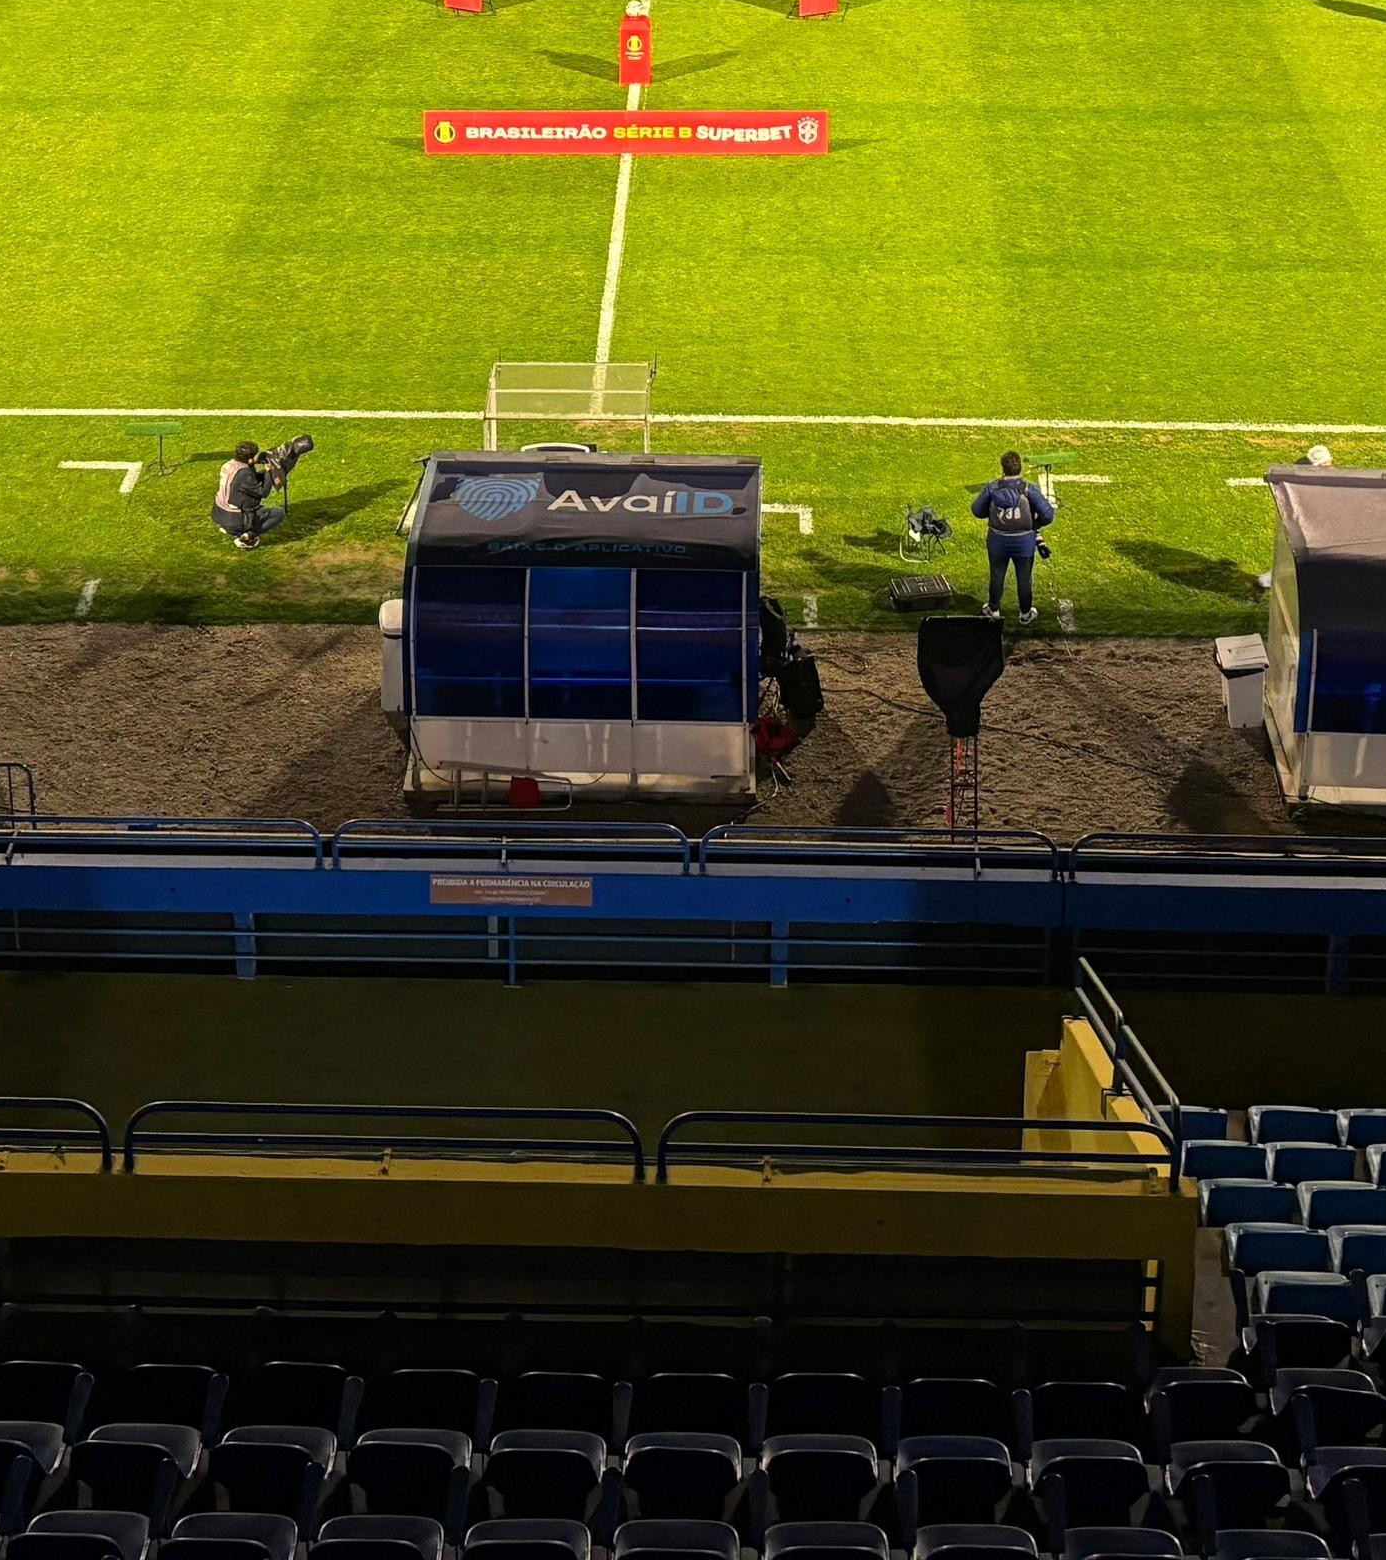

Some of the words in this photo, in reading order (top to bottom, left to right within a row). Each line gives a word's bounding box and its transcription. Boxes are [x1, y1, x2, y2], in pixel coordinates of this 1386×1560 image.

[465, 125, 607, 140] BRASILEIRÃO
[613, 123, 677, 139] SÉRIE
[679, 126, 693, 139] B
[696, 124, 792, 142] SUPERBET
[487, 543, 545, 552] BAIXE
[556, 544, 566, 552] O
[576, 543, 687, 553] APLICATIVO
